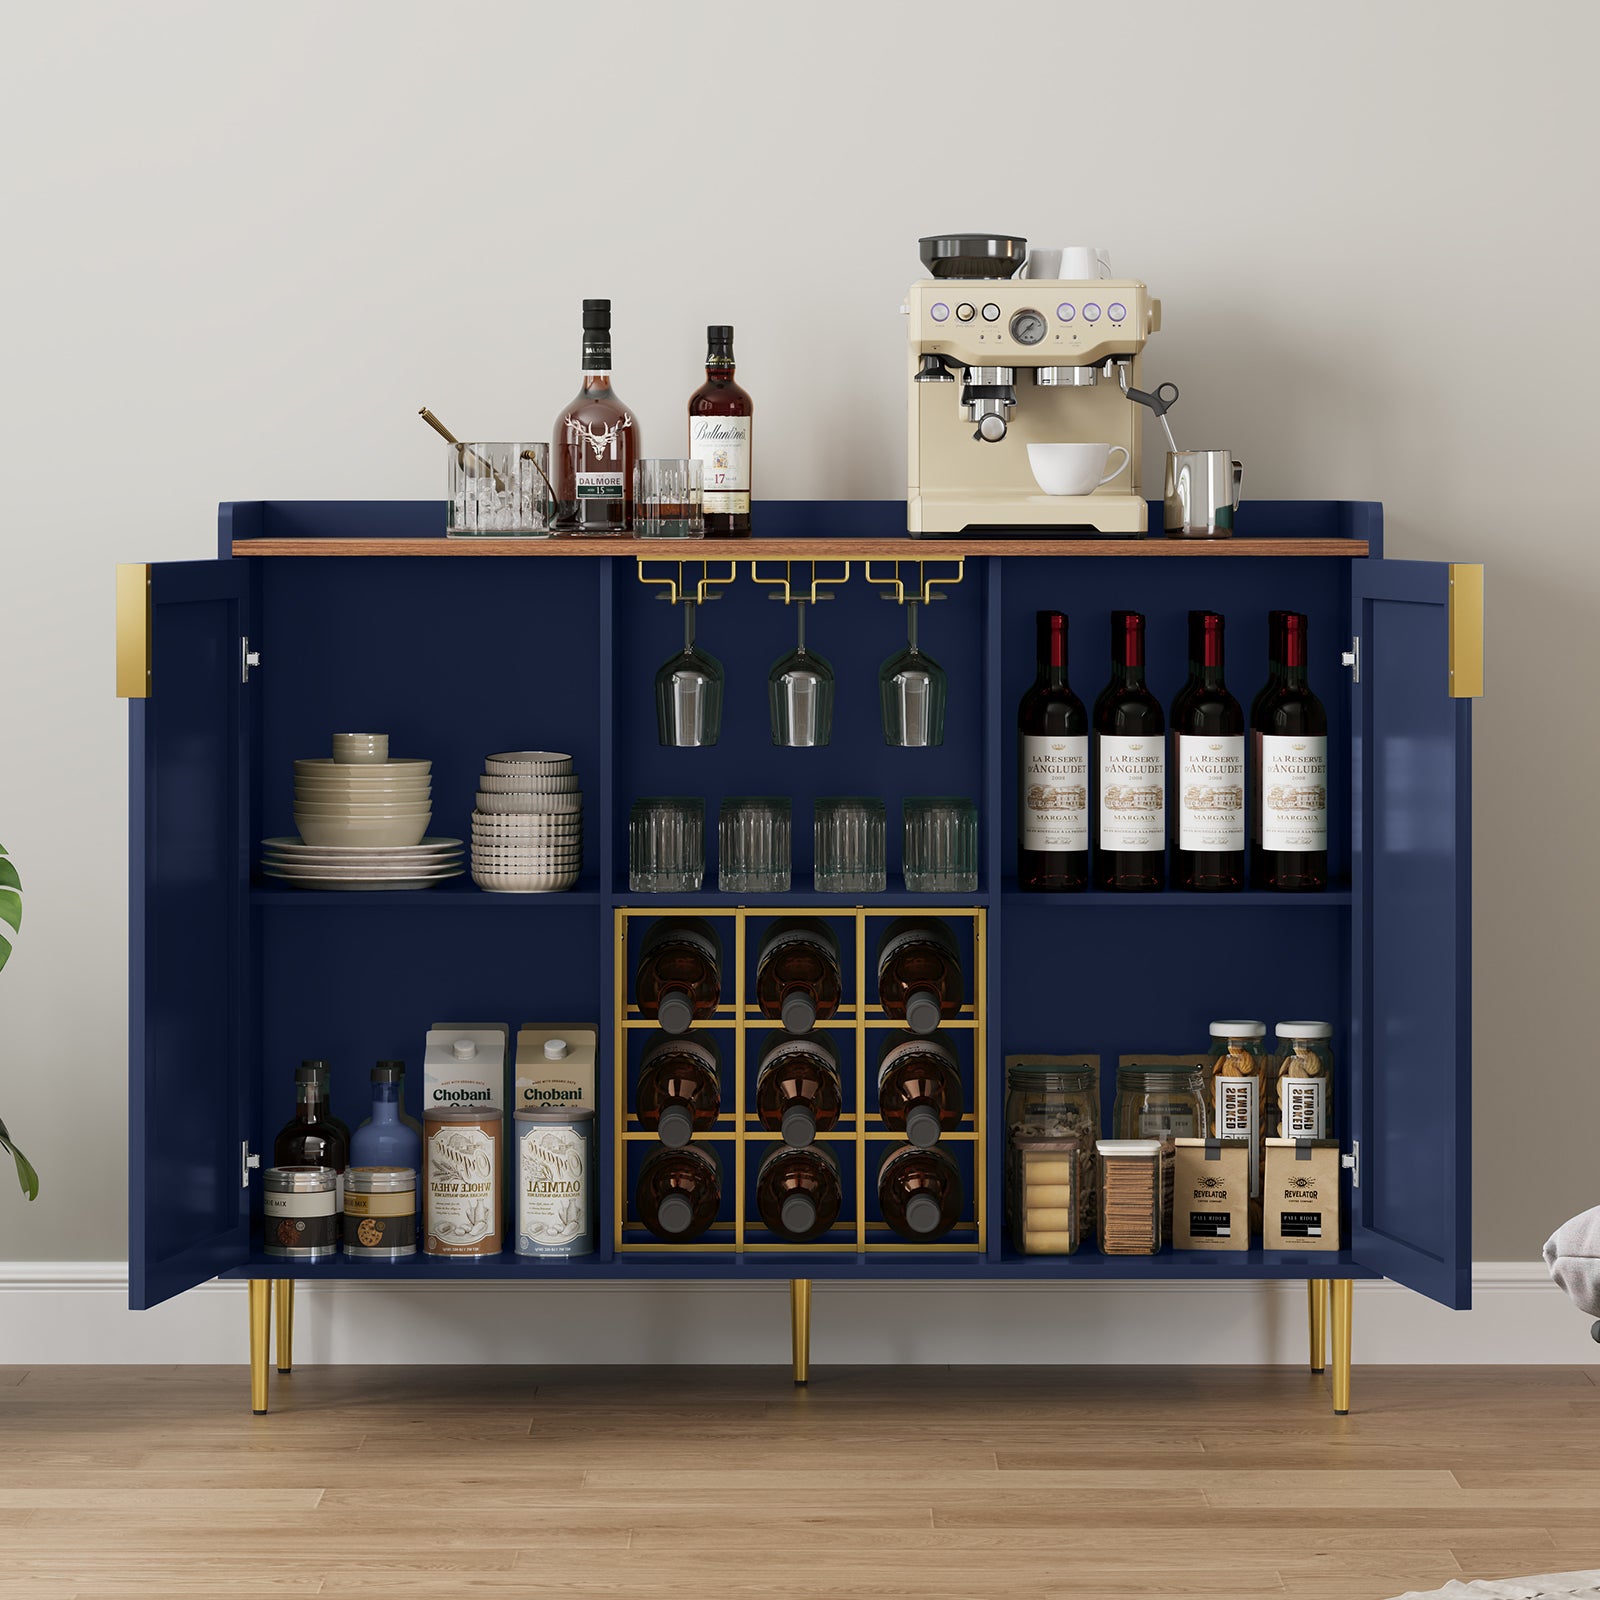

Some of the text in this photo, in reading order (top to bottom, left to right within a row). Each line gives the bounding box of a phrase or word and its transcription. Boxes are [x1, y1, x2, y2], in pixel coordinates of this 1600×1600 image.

[694, 420, 746, 440] Ballantine's
[715, 474, 725, 484] 17
[597, 486, 604, 494] 15
[433, 1088, 490, 1100] Chobani
[524, 1088, 582, 1100] Chobani
[1194, 1190, 1227, 1199] REVELATOR
[1285, 1190, 1318, 1199] REVELATOR
